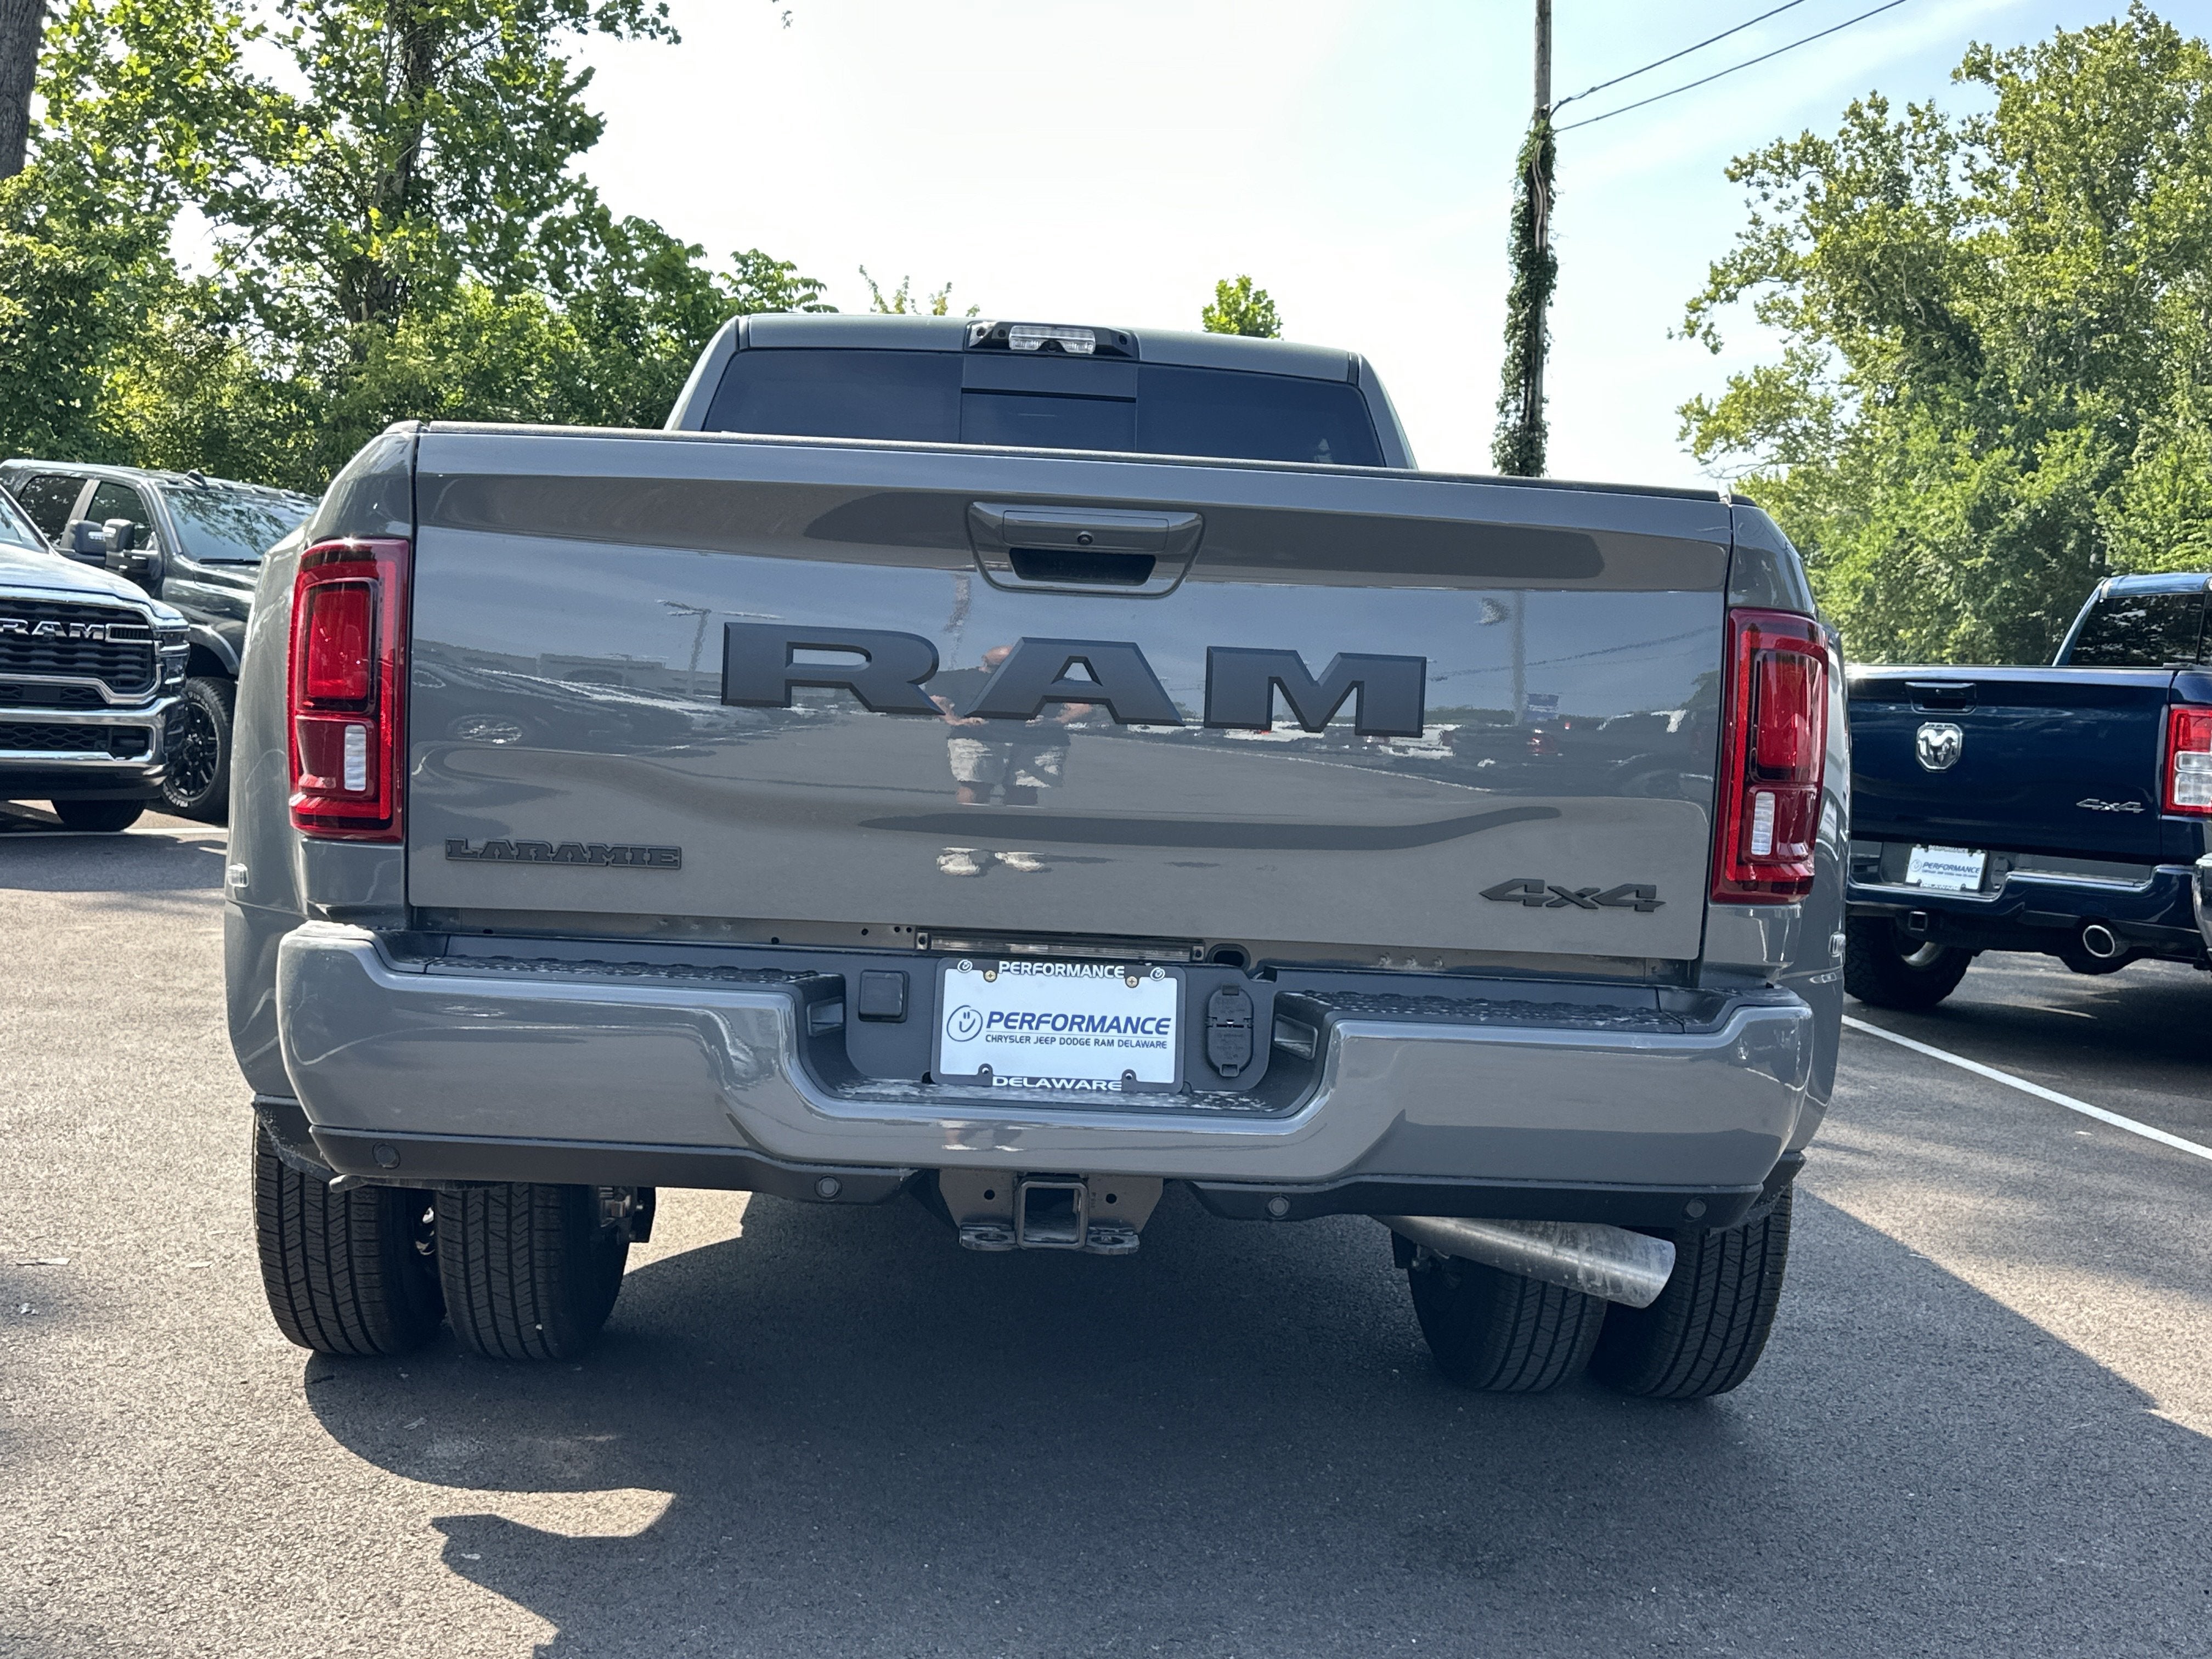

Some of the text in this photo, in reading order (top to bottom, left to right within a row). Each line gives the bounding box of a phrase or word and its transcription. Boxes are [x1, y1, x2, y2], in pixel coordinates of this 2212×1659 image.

[0, 618, 105, 640] RAM
[721, 622, 1427, 738] RAM
[445, 838, 682, 870] LARAMIE
[1922, 862, 1981, 874] PERFORMANCE
[1479, 878, 1666, 912] 4x4
[998, 961, 1125, 979] PERFORMANCE
[986, 1011, 1171, 1035] PERFORMANCE
[985, 1034, 1167, 1049] CHRYSLER JEEP DODGE RAM DELAWARE
[992, 1076, 1122, 1091] DELAWARE
